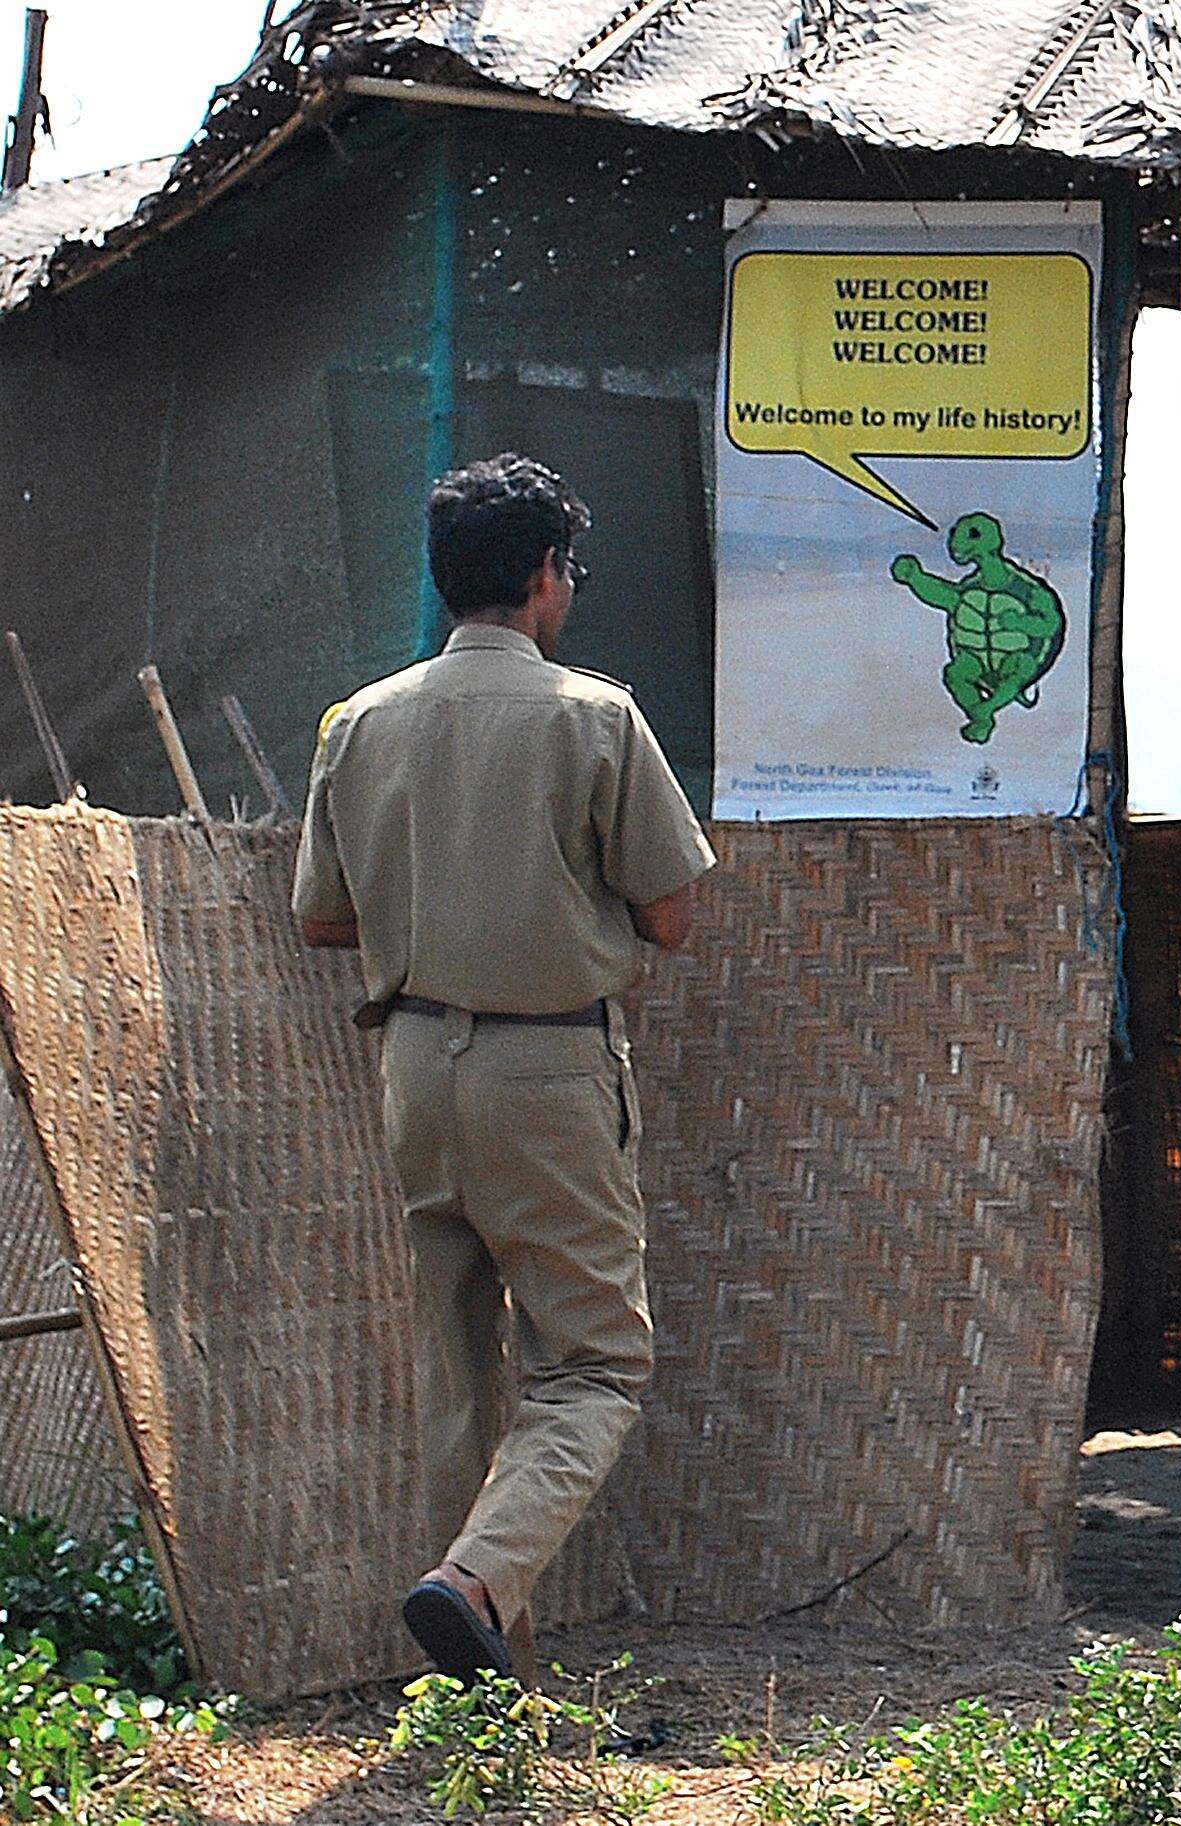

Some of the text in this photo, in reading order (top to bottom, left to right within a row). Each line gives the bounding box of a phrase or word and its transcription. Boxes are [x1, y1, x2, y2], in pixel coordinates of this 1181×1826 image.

[835, 278, 989, 300] WELCOME!
[834, 310, 987, 333] WELCOME!
[833, 342, 987, 365] WELCOME!
[735, 403, 1081, 435] Welcome to my life history!
